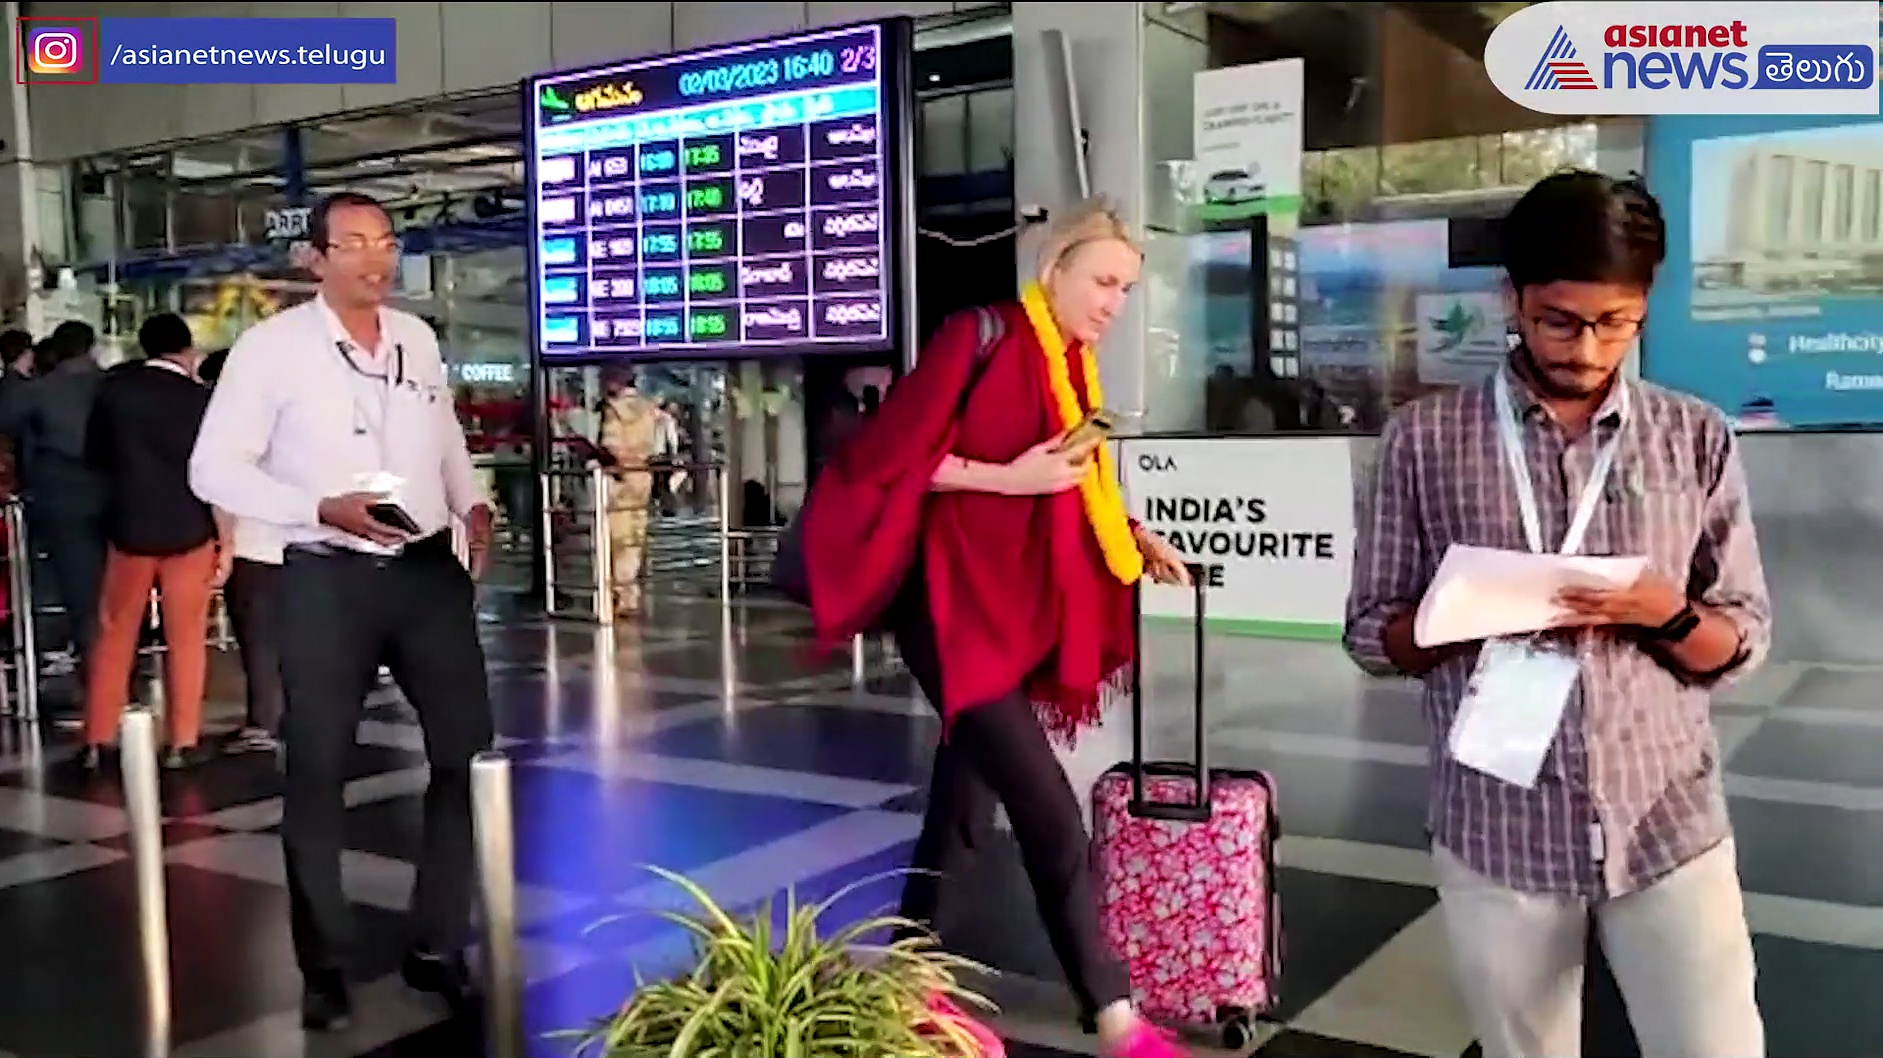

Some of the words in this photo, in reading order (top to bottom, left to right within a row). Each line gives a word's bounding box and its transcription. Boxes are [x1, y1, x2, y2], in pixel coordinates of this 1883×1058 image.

[783, 49, 835, 81] 16:40
[840, 44, 876, 74] 2/3
[461, 363, 514, 382] COFFEE
[1138, 454, 1177, 472] OLA
[1153, 530, 1334, 558] AVOURITE
